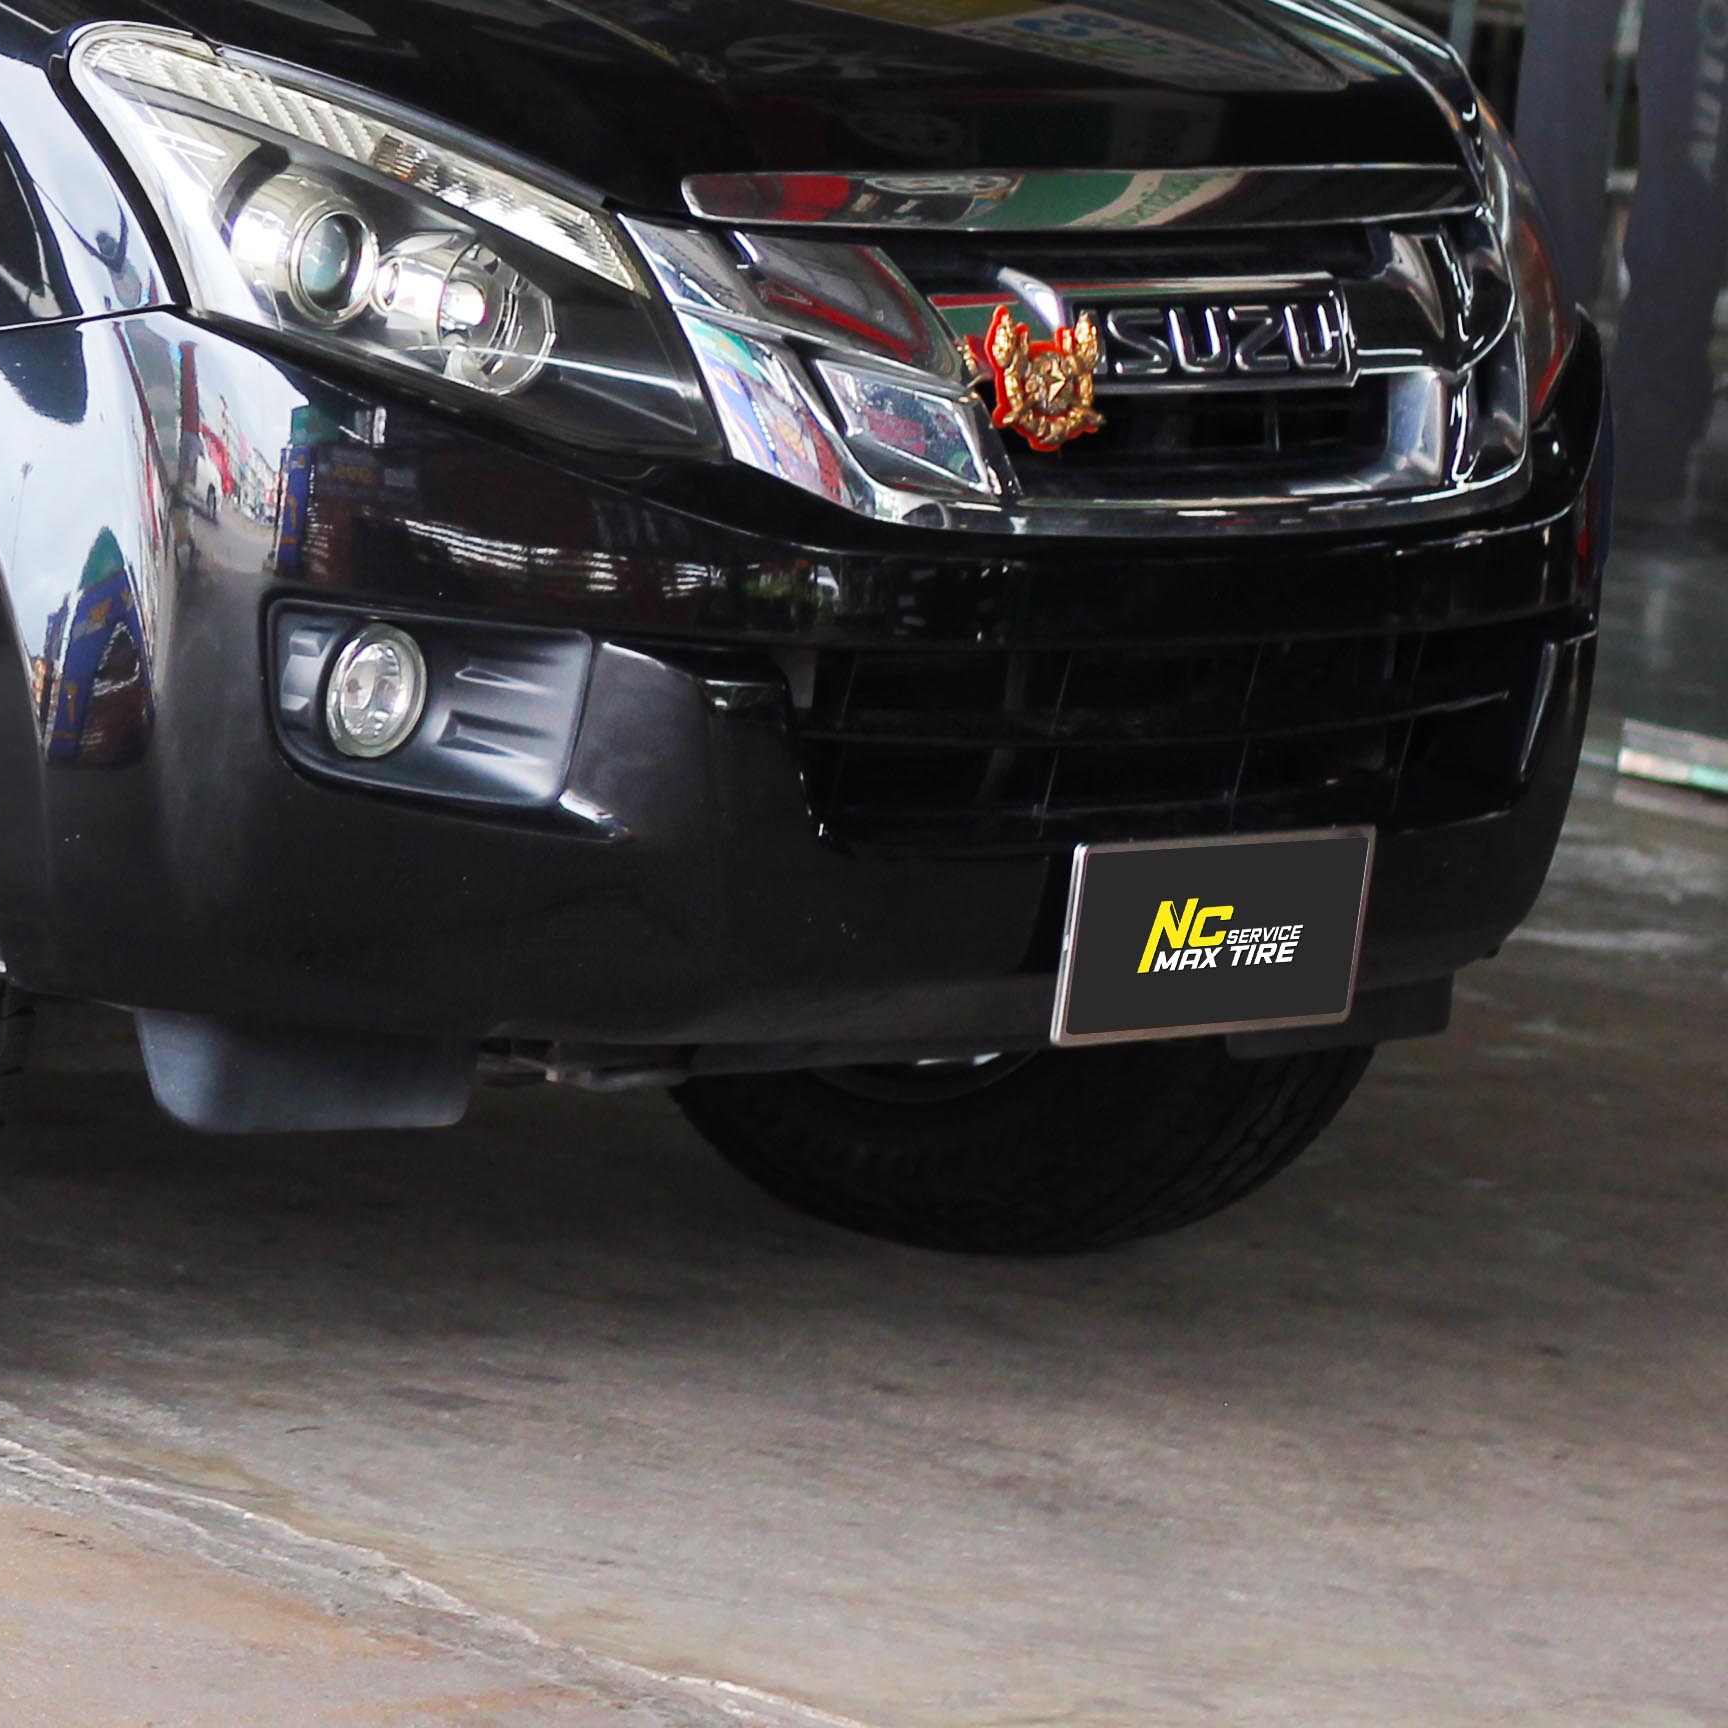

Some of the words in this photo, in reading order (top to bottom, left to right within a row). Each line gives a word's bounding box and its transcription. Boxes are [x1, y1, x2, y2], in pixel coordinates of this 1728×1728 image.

[1137, 898, 1234, 974] NC
[1227, 924, 1304, 945] SERVICE
[1153, 947, 1222, 973] MAX
[1230, 940, 1299, 967] TIRE
